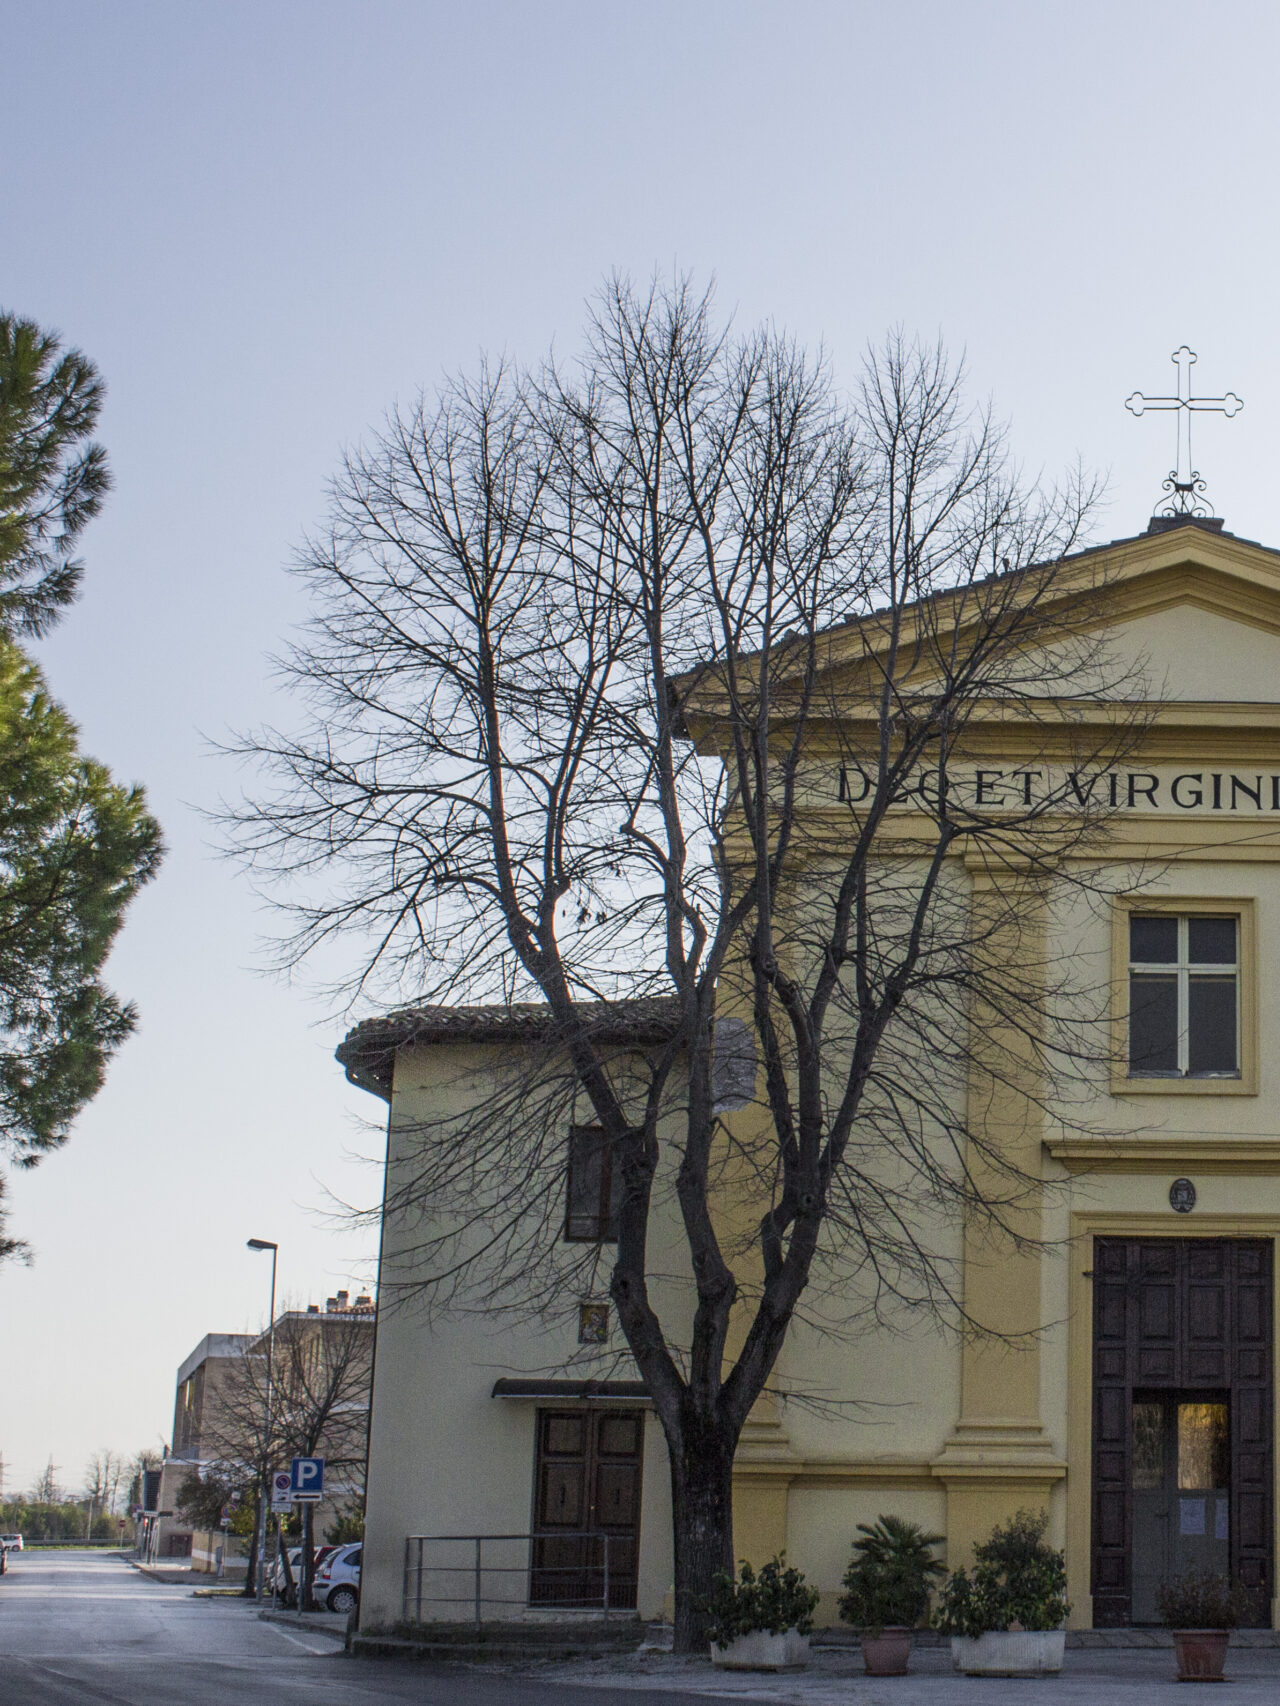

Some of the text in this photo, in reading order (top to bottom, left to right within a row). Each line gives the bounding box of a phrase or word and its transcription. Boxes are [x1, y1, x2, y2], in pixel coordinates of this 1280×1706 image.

[974, 770, 1042, 806] ET
[1067, 772, 1280, 810] VIRGINI
[297, 1461, 318, 1488] P
